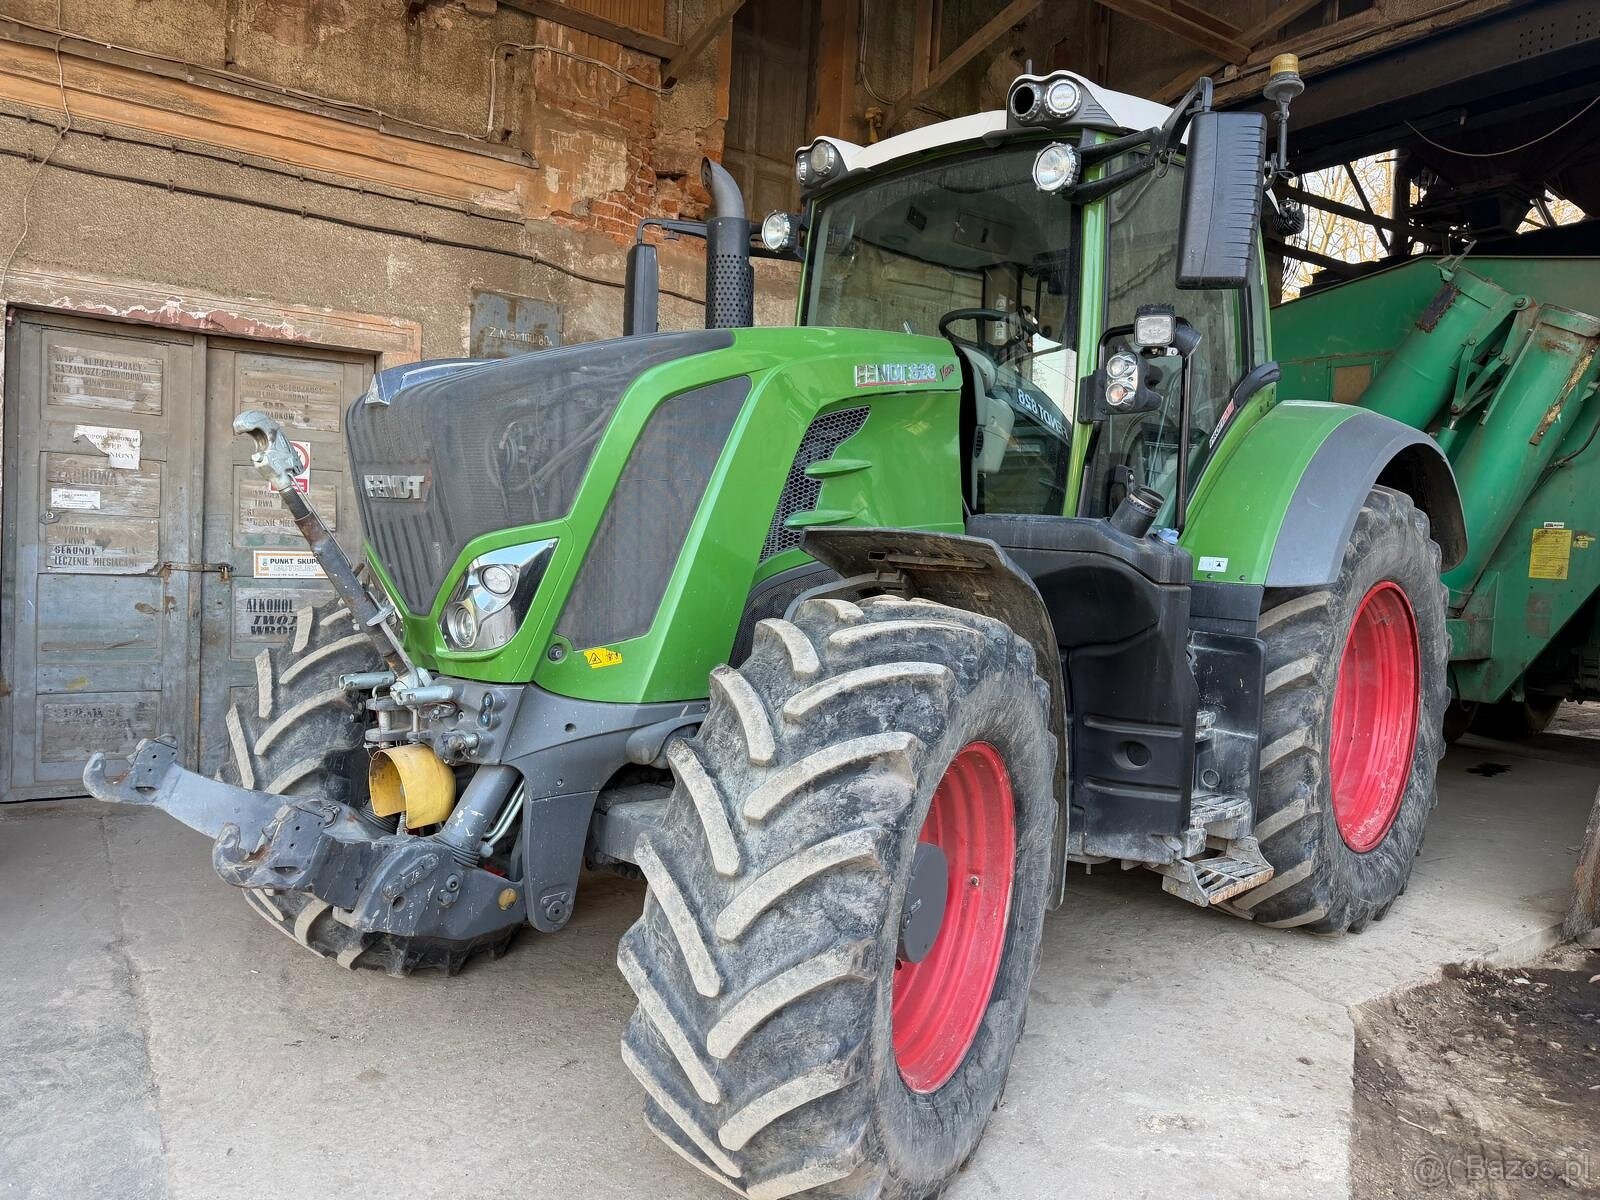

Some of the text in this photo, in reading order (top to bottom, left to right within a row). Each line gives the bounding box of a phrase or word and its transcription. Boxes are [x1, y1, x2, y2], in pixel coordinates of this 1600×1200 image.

[854, 364, 907, 386] FENDT
[364, 474, 425, 499] FENDT
[54, 545, 97, 555] SEKUNDY
[54, 555, 89, 566] LECZENIE
[246, 598, 294, 613] ALKOHOL
